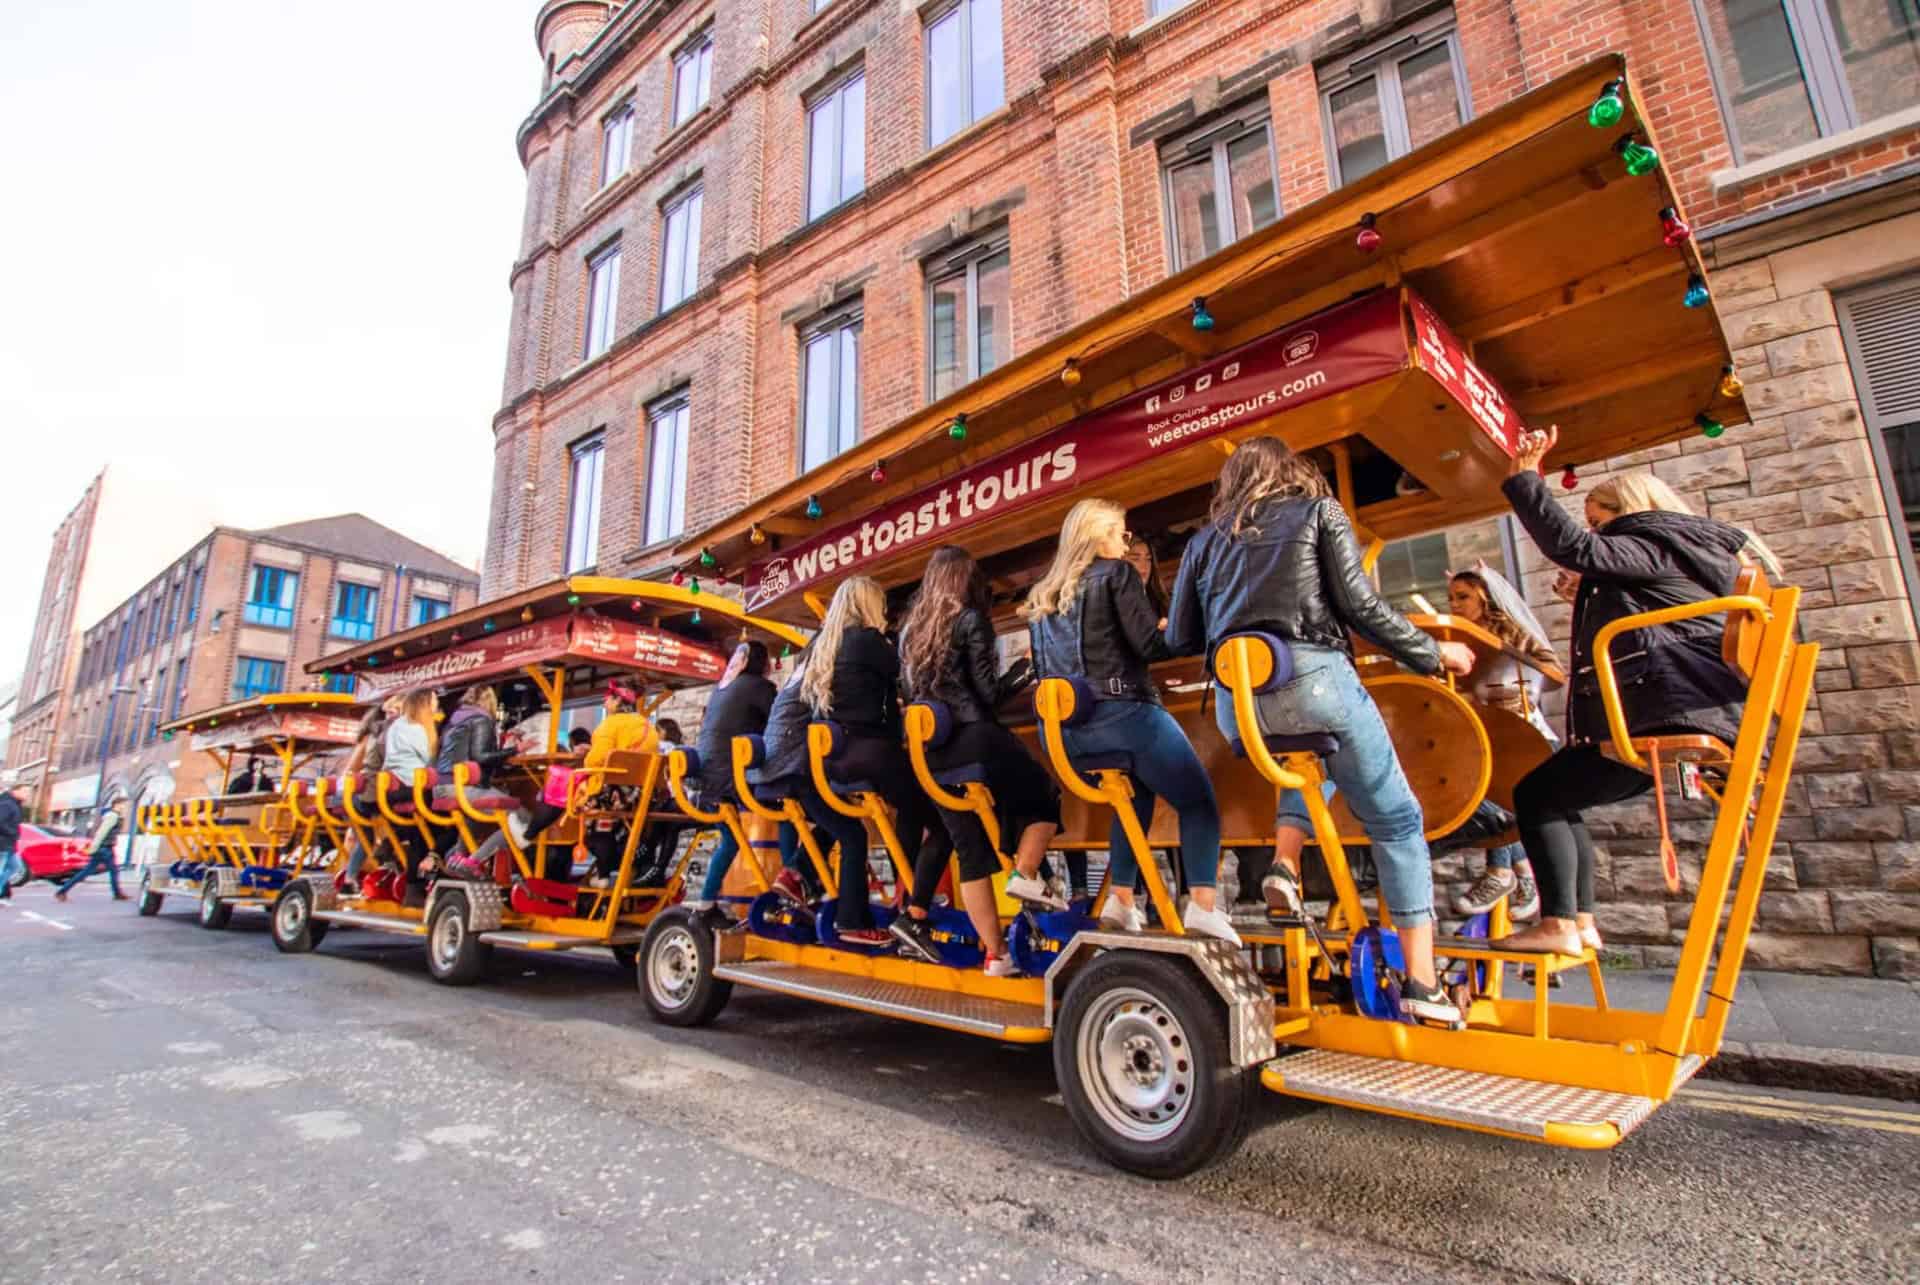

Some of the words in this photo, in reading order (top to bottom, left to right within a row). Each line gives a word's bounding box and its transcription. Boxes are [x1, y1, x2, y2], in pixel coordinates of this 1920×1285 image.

[1147, 419, 1170, 433] Book
[1171, 404, 1208, 424] Online
[1148, 370, 1327, 448] weetoasttours.com
